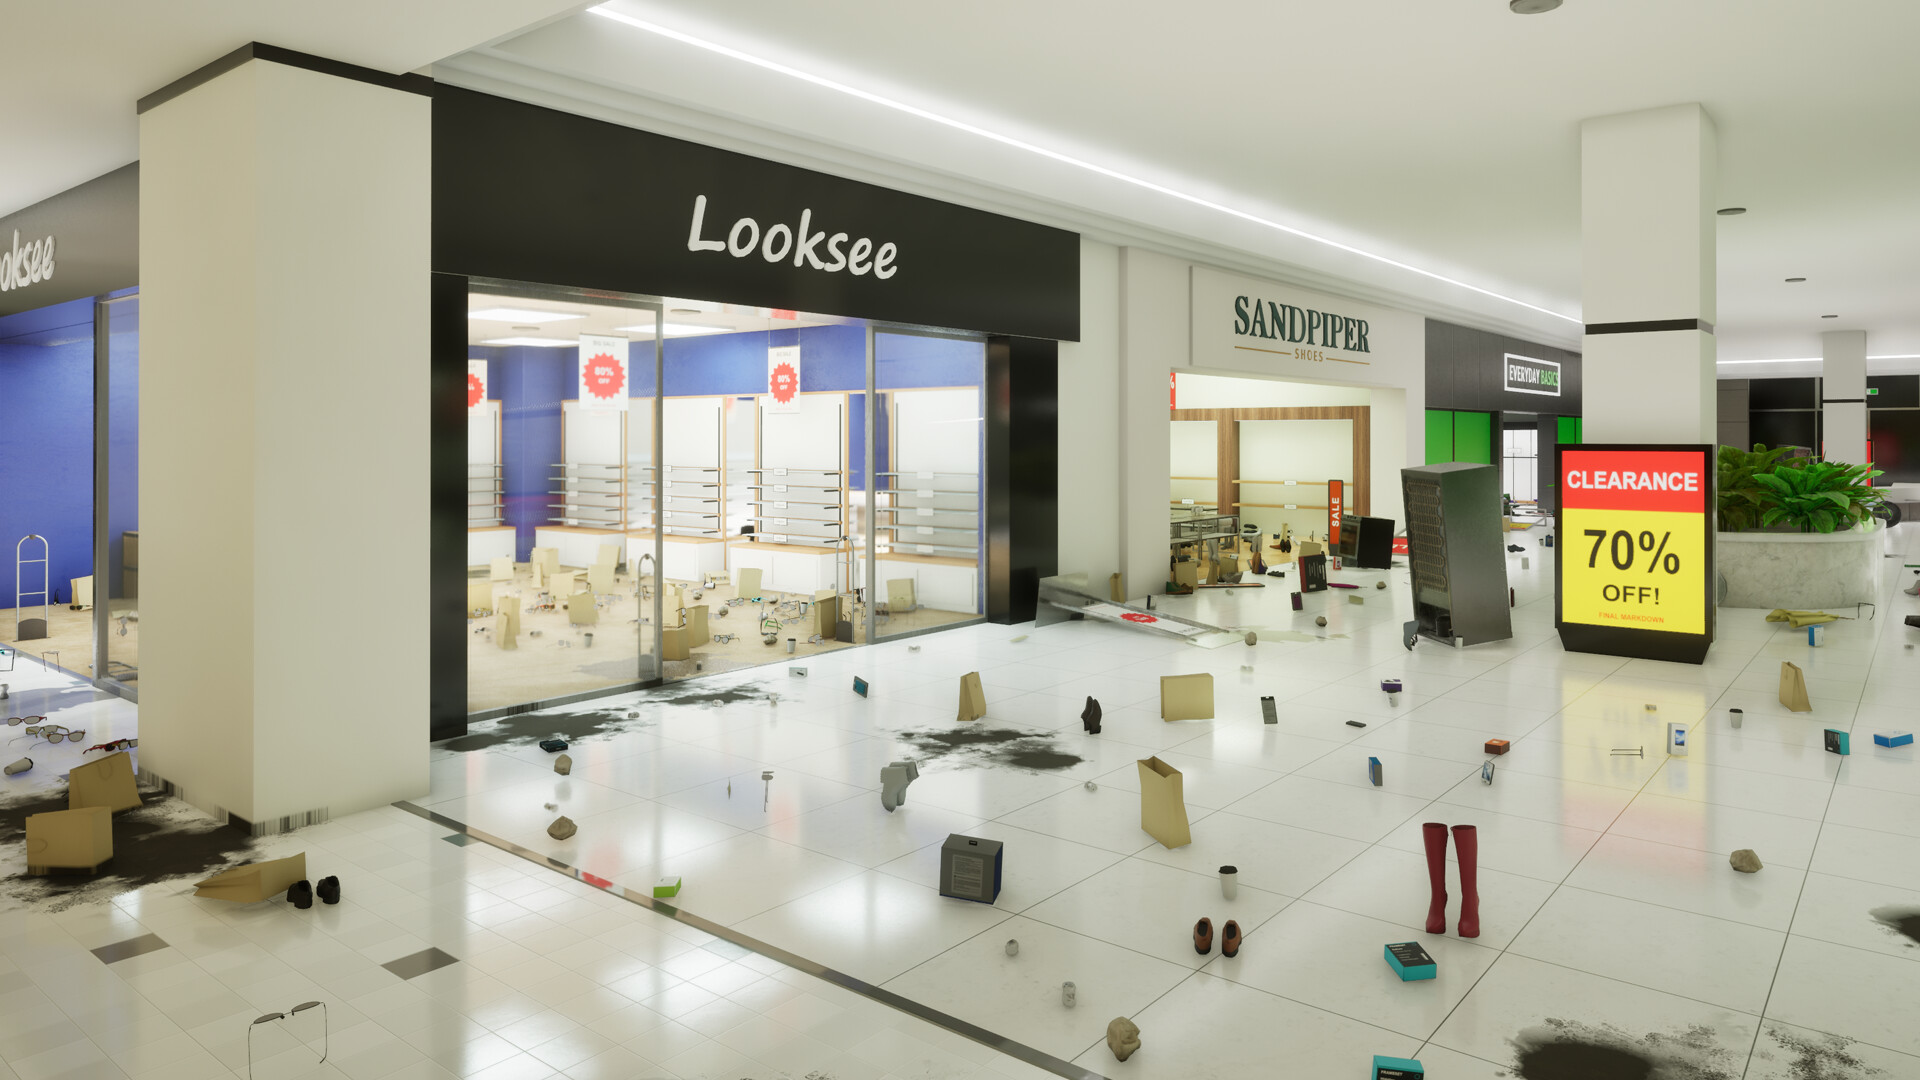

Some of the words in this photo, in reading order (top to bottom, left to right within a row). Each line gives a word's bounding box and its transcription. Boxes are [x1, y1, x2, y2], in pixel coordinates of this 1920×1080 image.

[687, 194, 898, 280] Looksee
[0, 228, 56, 291] oksee
[1234, 295, 1371, 354] SANDPIPER
[1294, 347, 1324, 363] SHOES
[594, 366, 615, 377] 80%
[1509, 364, 1541, 385] EVERYDAY
[1540, 369, 1559, 387] BASICS
[1567, 470, 1699, 492] CLEARANCE
[1331, 497, 1340, 527] SALE
[1584, 529, 1680, 575] 70%
[1602, 584, 1660, 605] OFF!
[1598, 611, 1618, 620] FINAL
[1621, 613, 1665, 624] MARKDOWN
